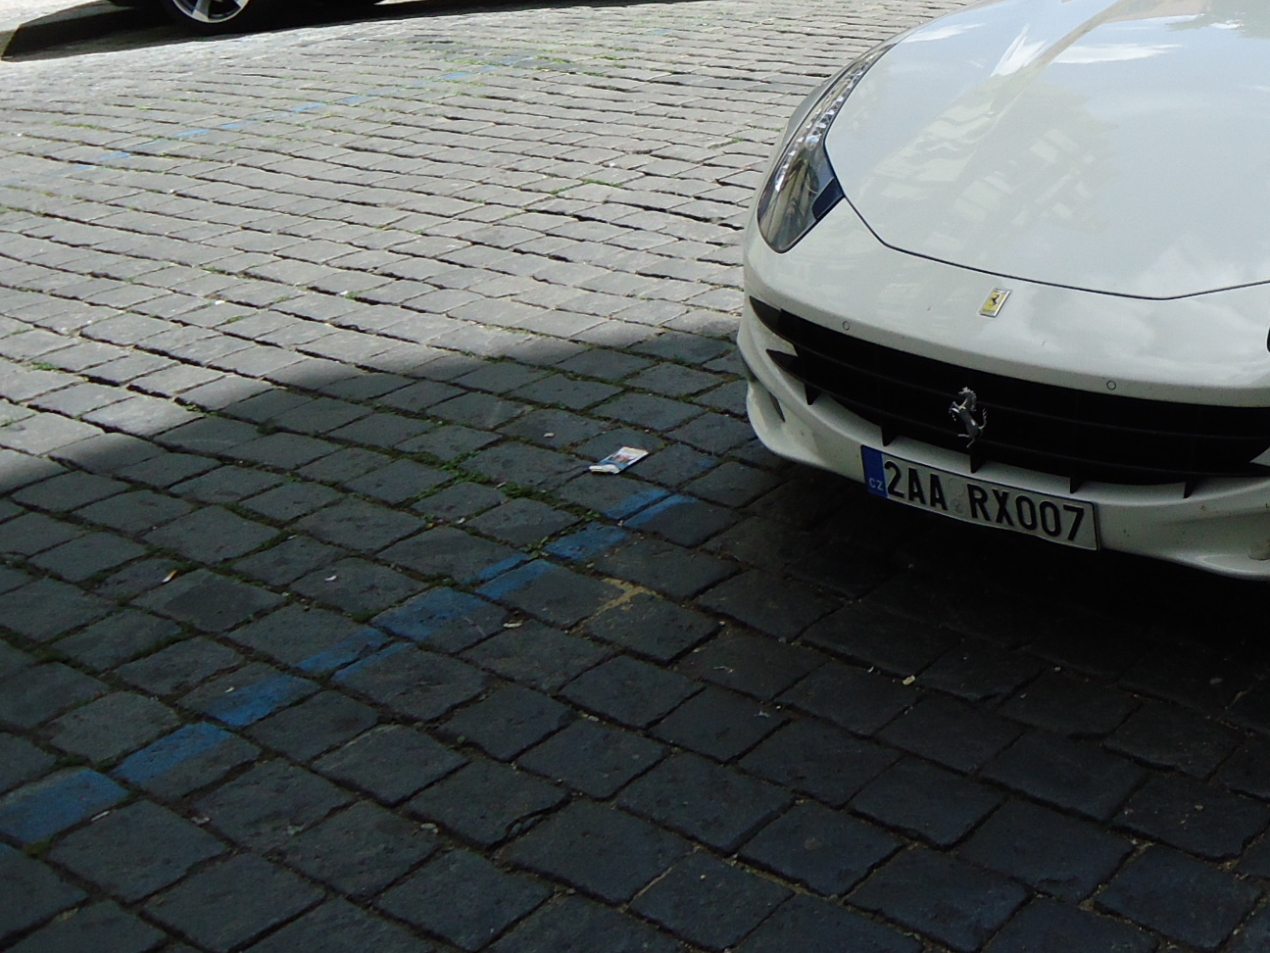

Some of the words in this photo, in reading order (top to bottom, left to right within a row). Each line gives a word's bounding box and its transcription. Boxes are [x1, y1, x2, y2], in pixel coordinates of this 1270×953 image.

[869, 477, 884, 491] CZ
[884, 461, 948, 511] 2AA
[967, 484, 1085, 541] RX007
